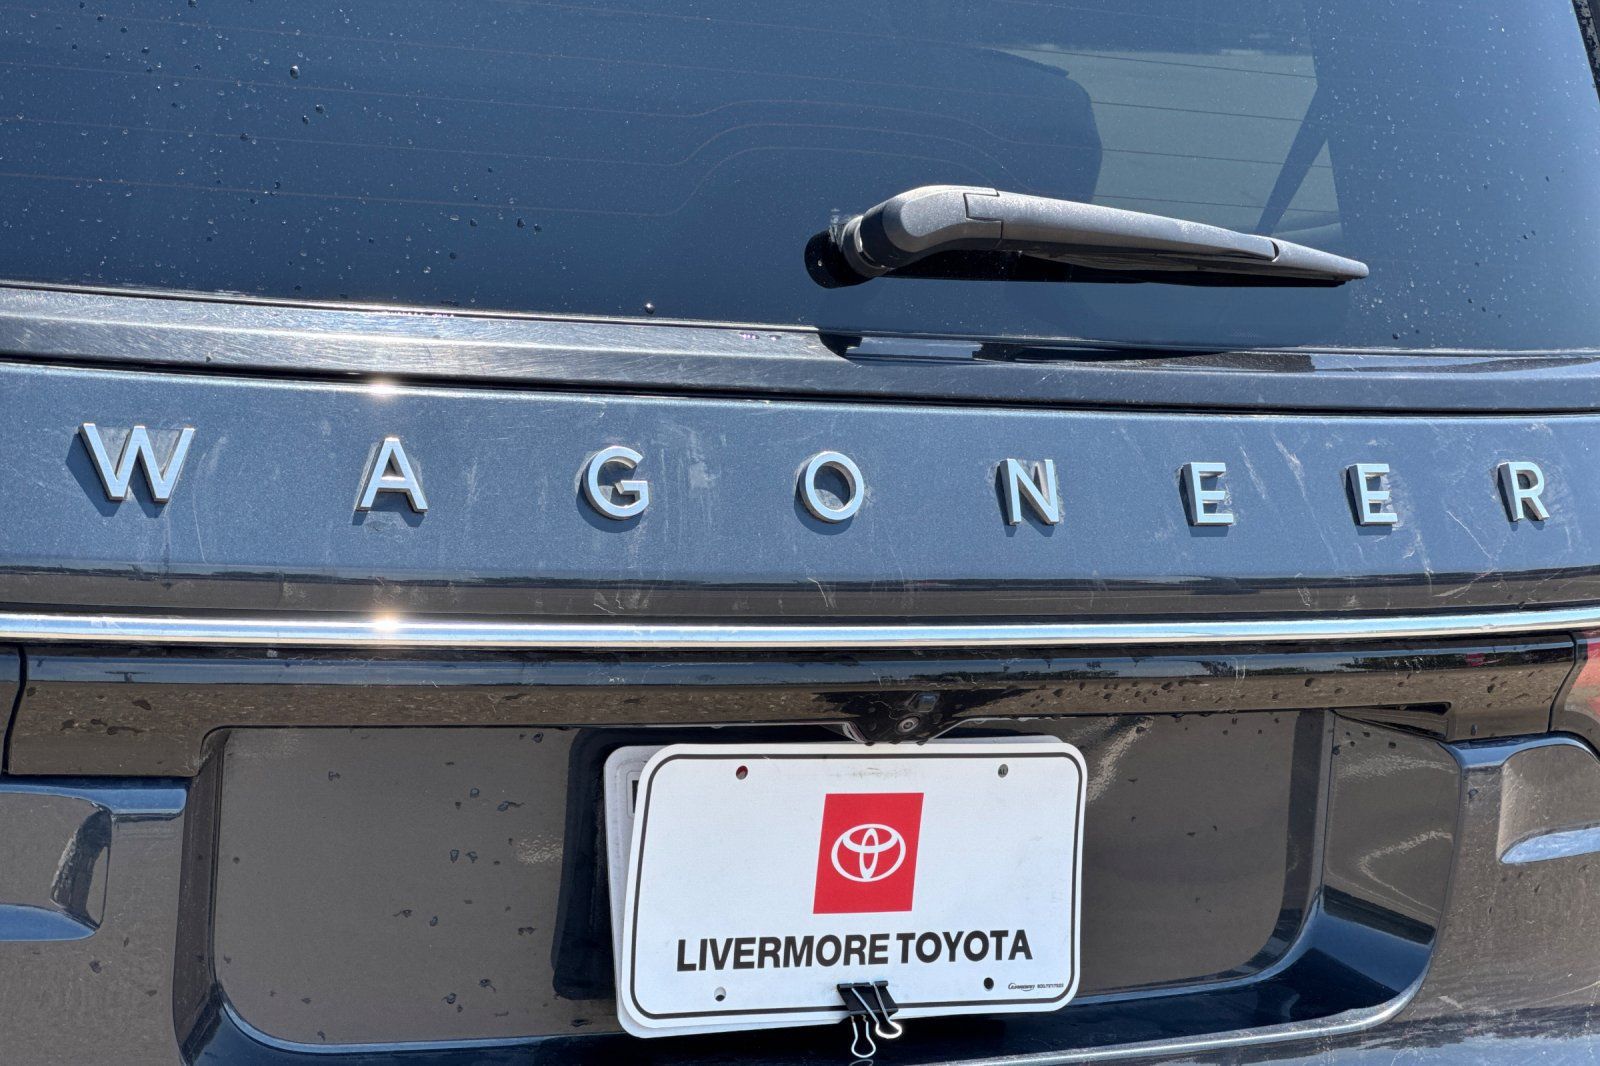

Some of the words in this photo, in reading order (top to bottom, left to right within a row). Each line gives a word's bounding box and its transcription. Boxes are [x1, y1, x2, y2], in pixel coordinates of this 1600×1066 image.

[79, 422, 1549, 526] WAGONEER
[677, 933, 890, 971] LIVERMORE
[896, 929, 1033, 963] TOYOTA
